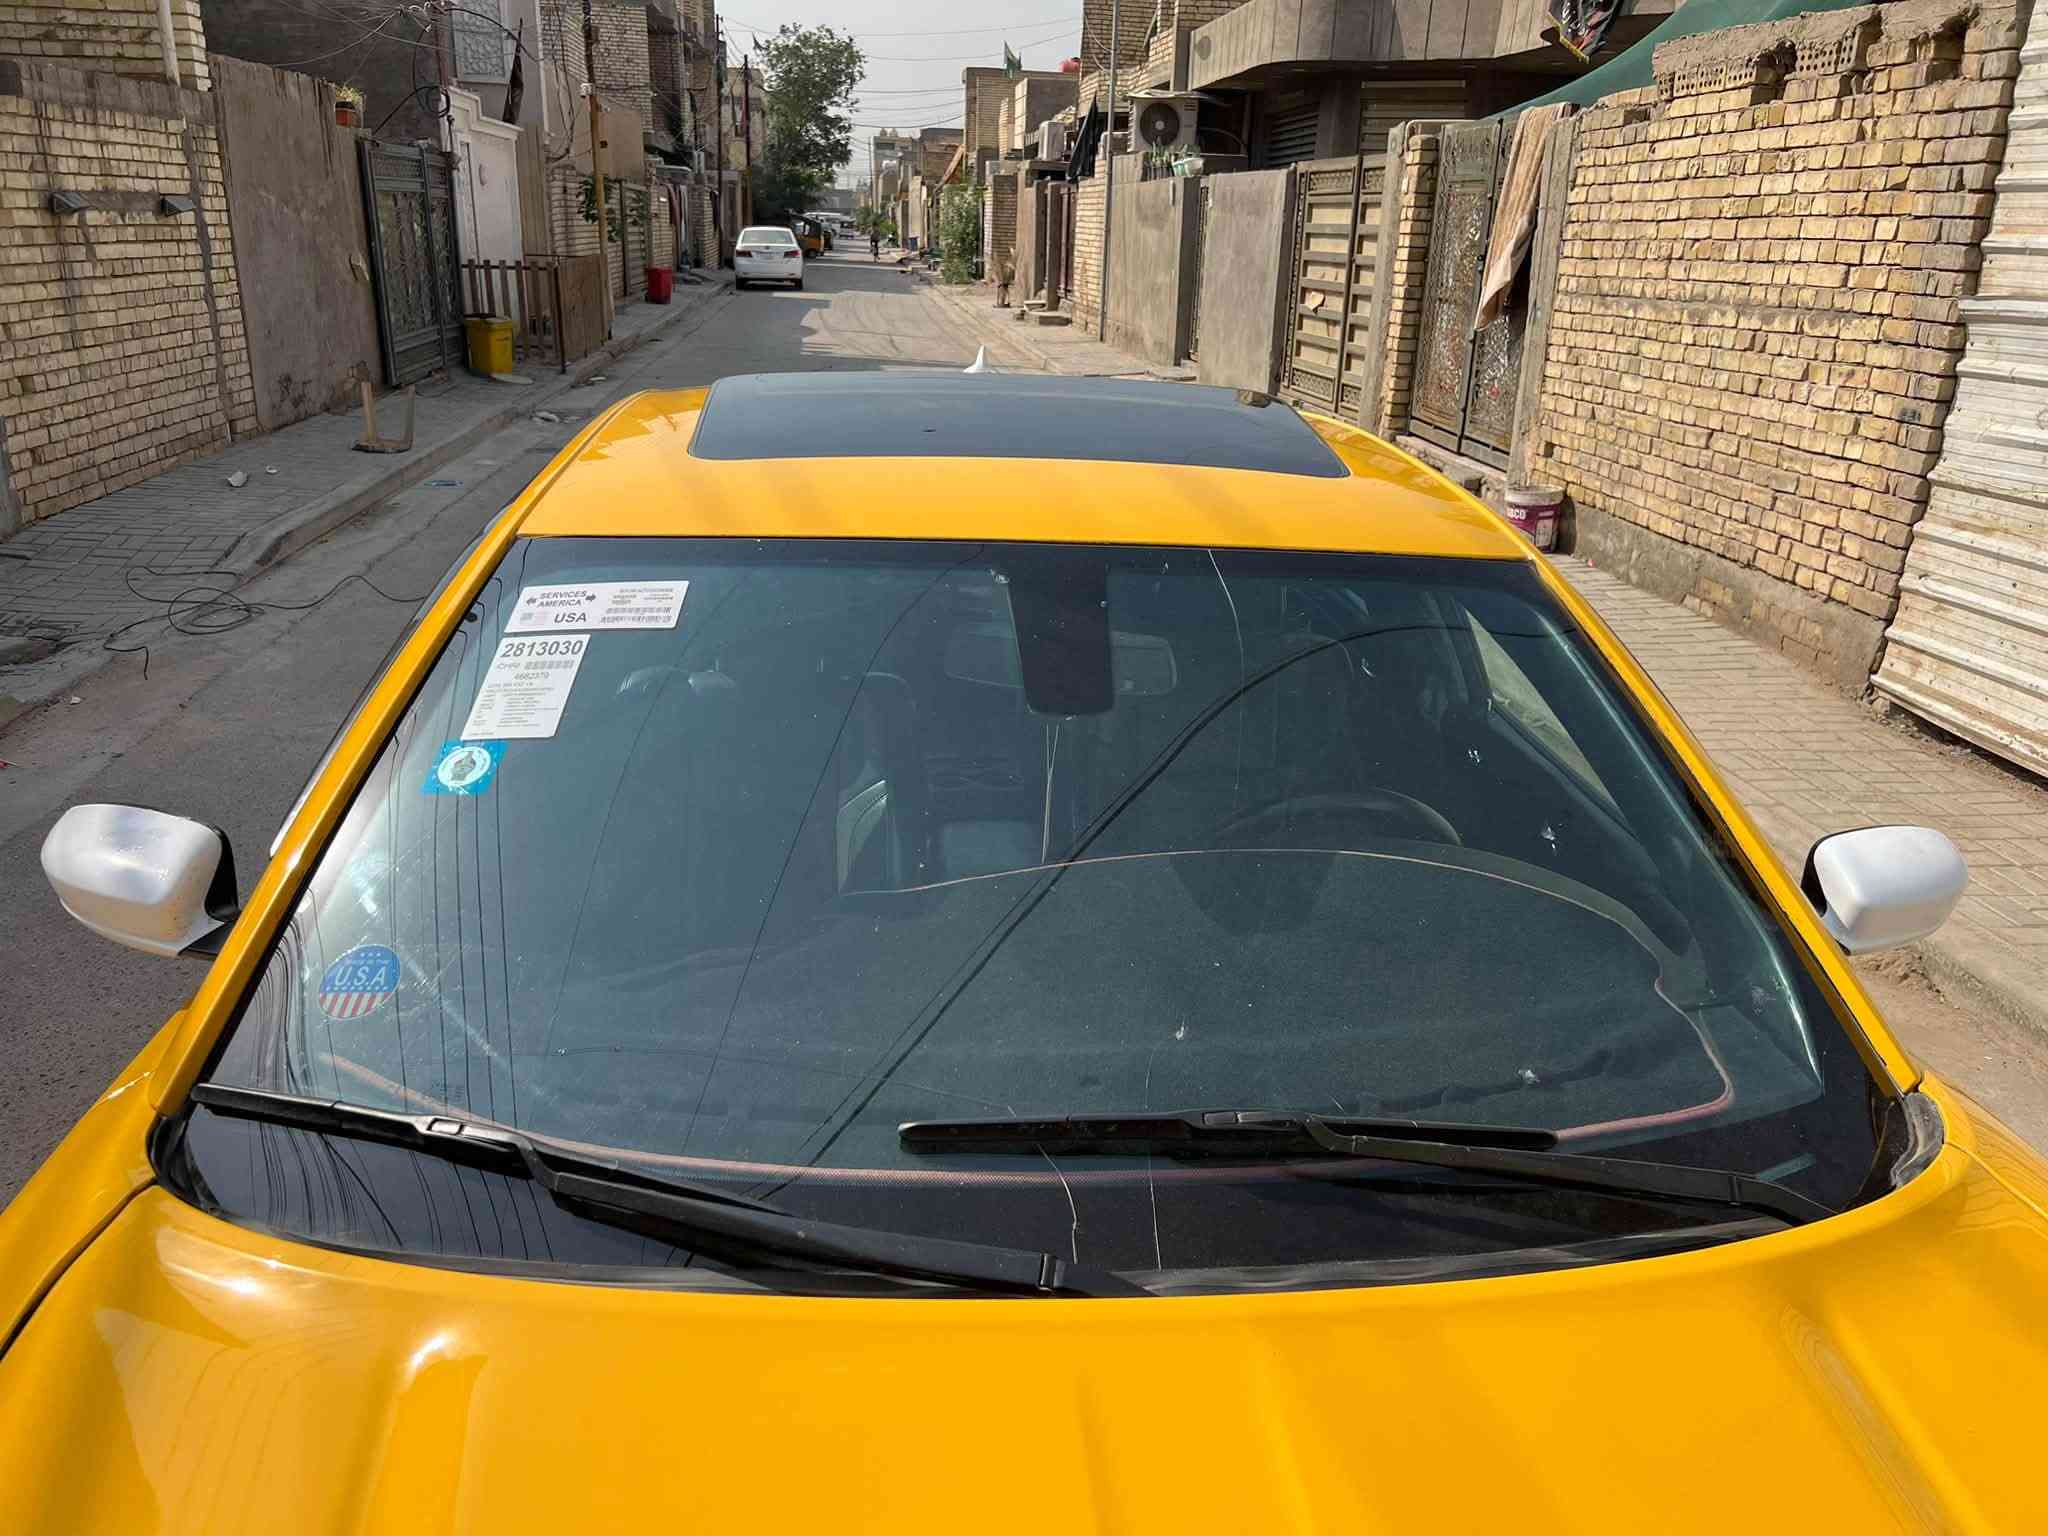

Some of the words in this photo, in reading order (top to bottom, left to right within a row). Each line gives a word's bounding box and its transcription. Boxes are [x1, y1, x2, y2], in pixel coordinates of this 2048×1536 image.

[538, 590, 587, 600] SERVICES
[537, 599, 582, 608] AMERICA
[553, 612, 587, 624] USA
[499, 640, 584, 658] 2813030
